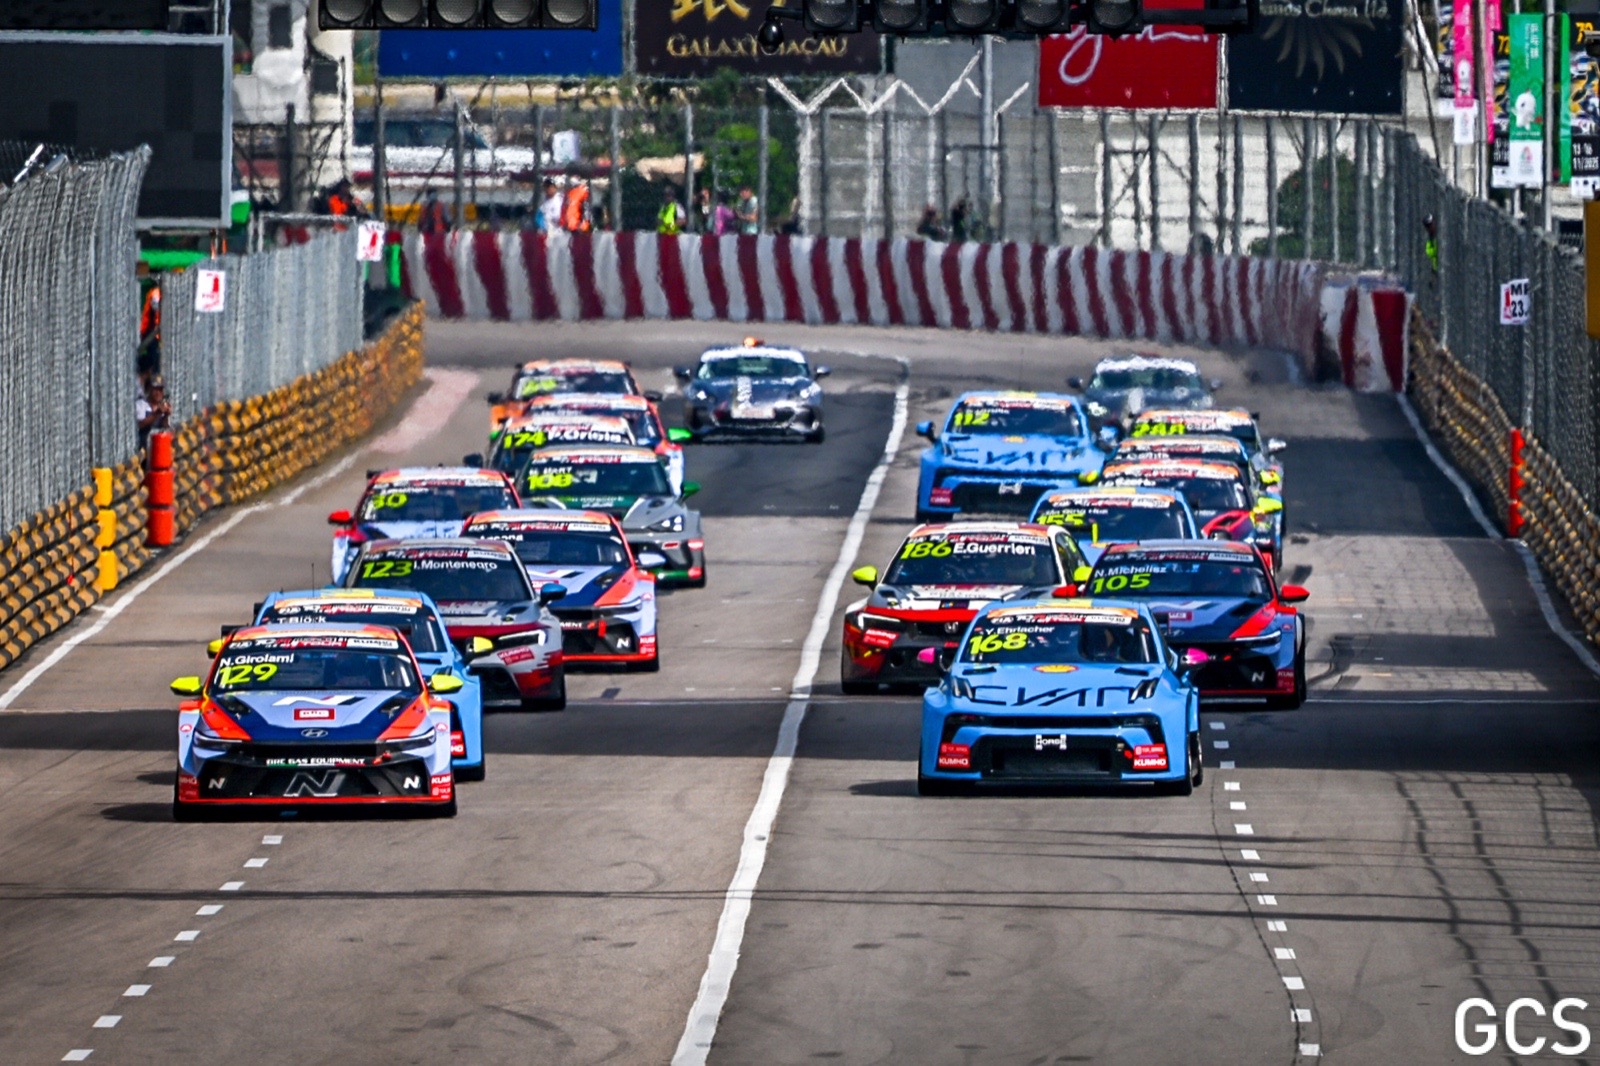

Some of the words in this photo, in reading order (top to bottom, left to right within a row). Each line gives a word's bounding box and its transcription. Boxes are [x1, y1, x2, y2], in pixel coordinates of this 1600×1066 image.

[667, 34, 757, 57] GALAXY
[761, 36, 848, 56] ACAU
[503, 431, 546, 449] 174
[1037, 513, 1085, 526] 155
[901, 540, 952, 559] 186
[362, 560, 413, 578] 123
[1093, 573, 1150, 594] 105
[970, 632, 1028, 655] 168
[219, 653, 295, 667] N.Girolami
[219, 663, 278, 685] 129
[938, 757, 969, 767] KUMHO
[1133, 757, 1167, 767] KUMHO
